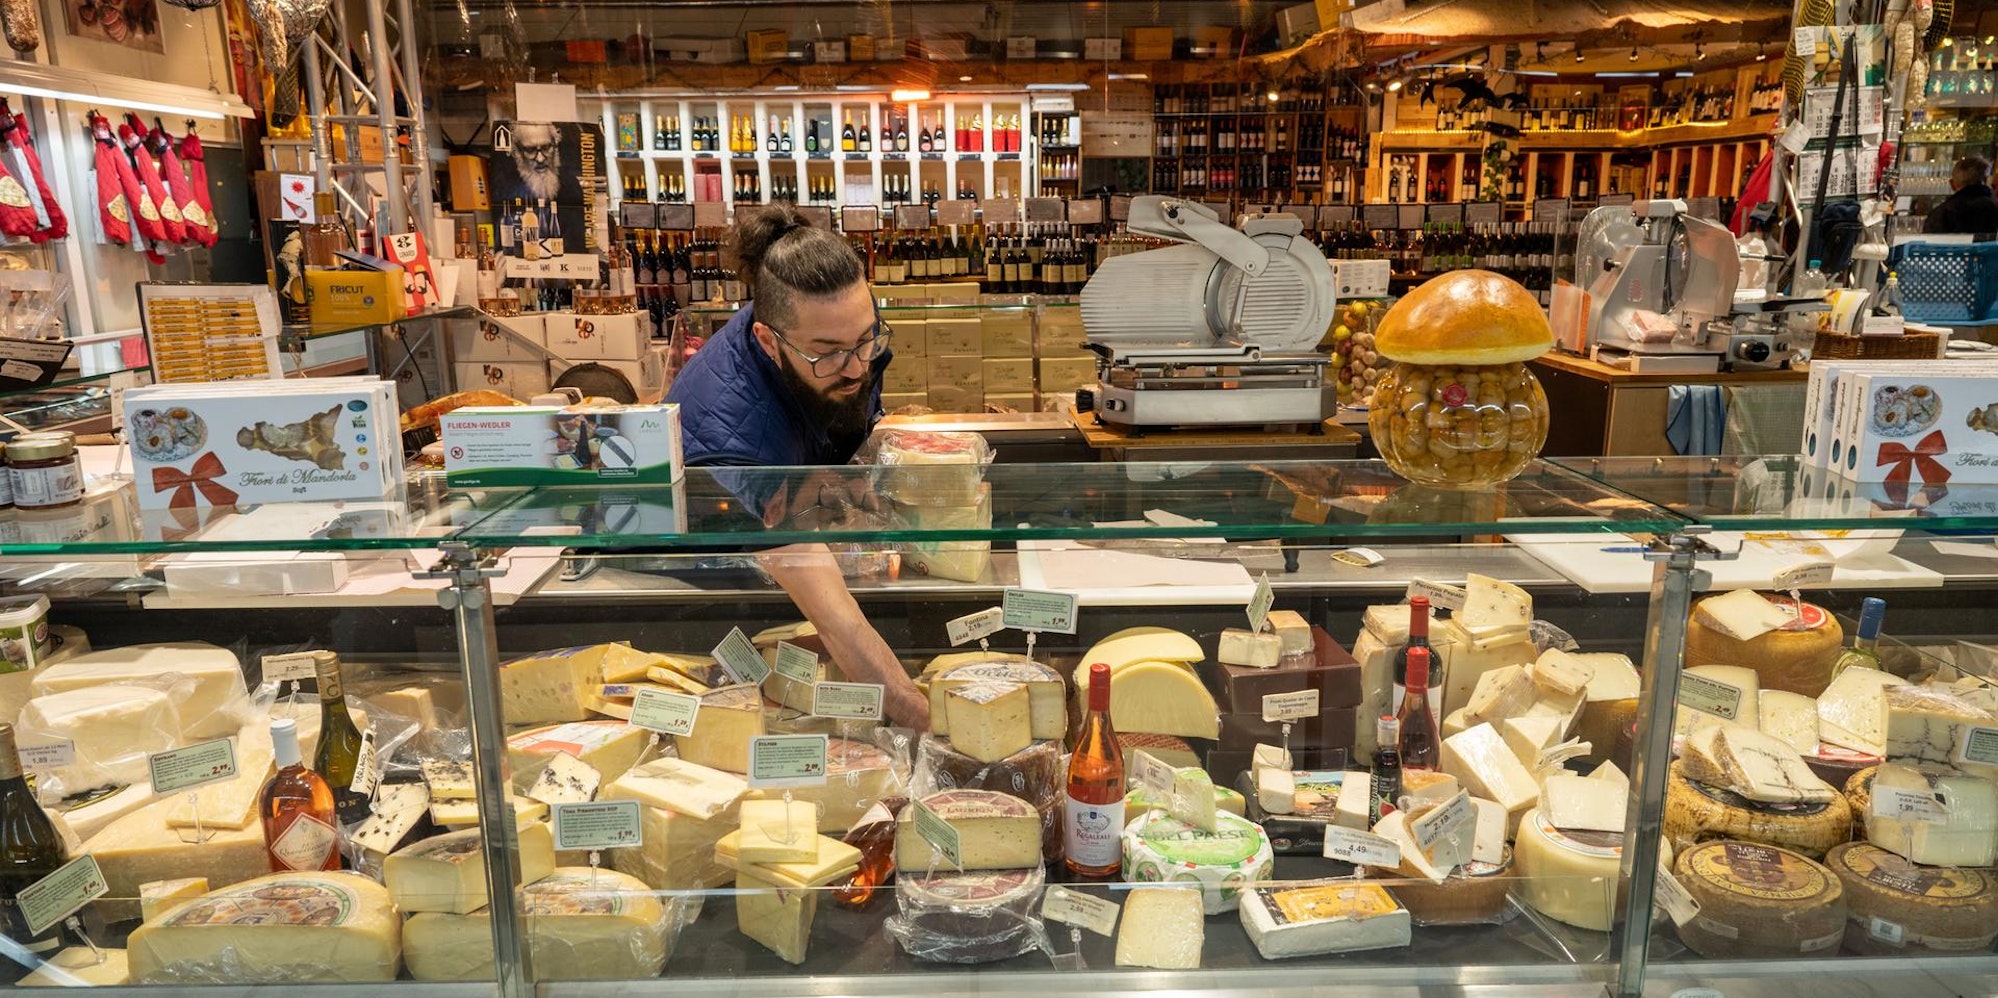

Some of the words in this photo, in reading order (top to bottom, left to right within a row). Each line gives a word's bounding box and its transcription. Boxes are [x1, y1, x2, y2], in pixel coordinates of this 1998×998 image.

[580, 132, 597, 205] WASHINGTON
[584, 207, 598, 227] ARE
[329, 285, 364, 294] FRICUT
[447, 421, 511, 430] FLIEGEN-WEDLER
[1955, 452, 1988, 467] Fiori
[239, 472, 274, 487] Fiori
[276, 473, 288, 485] di
[292, 468, 357, 484] Mandorla
[964, 614, 989, 627] Fontina
[1192, 828, 1250, 841] PAESE
[1348, 844, 1367, 854] 4,49
